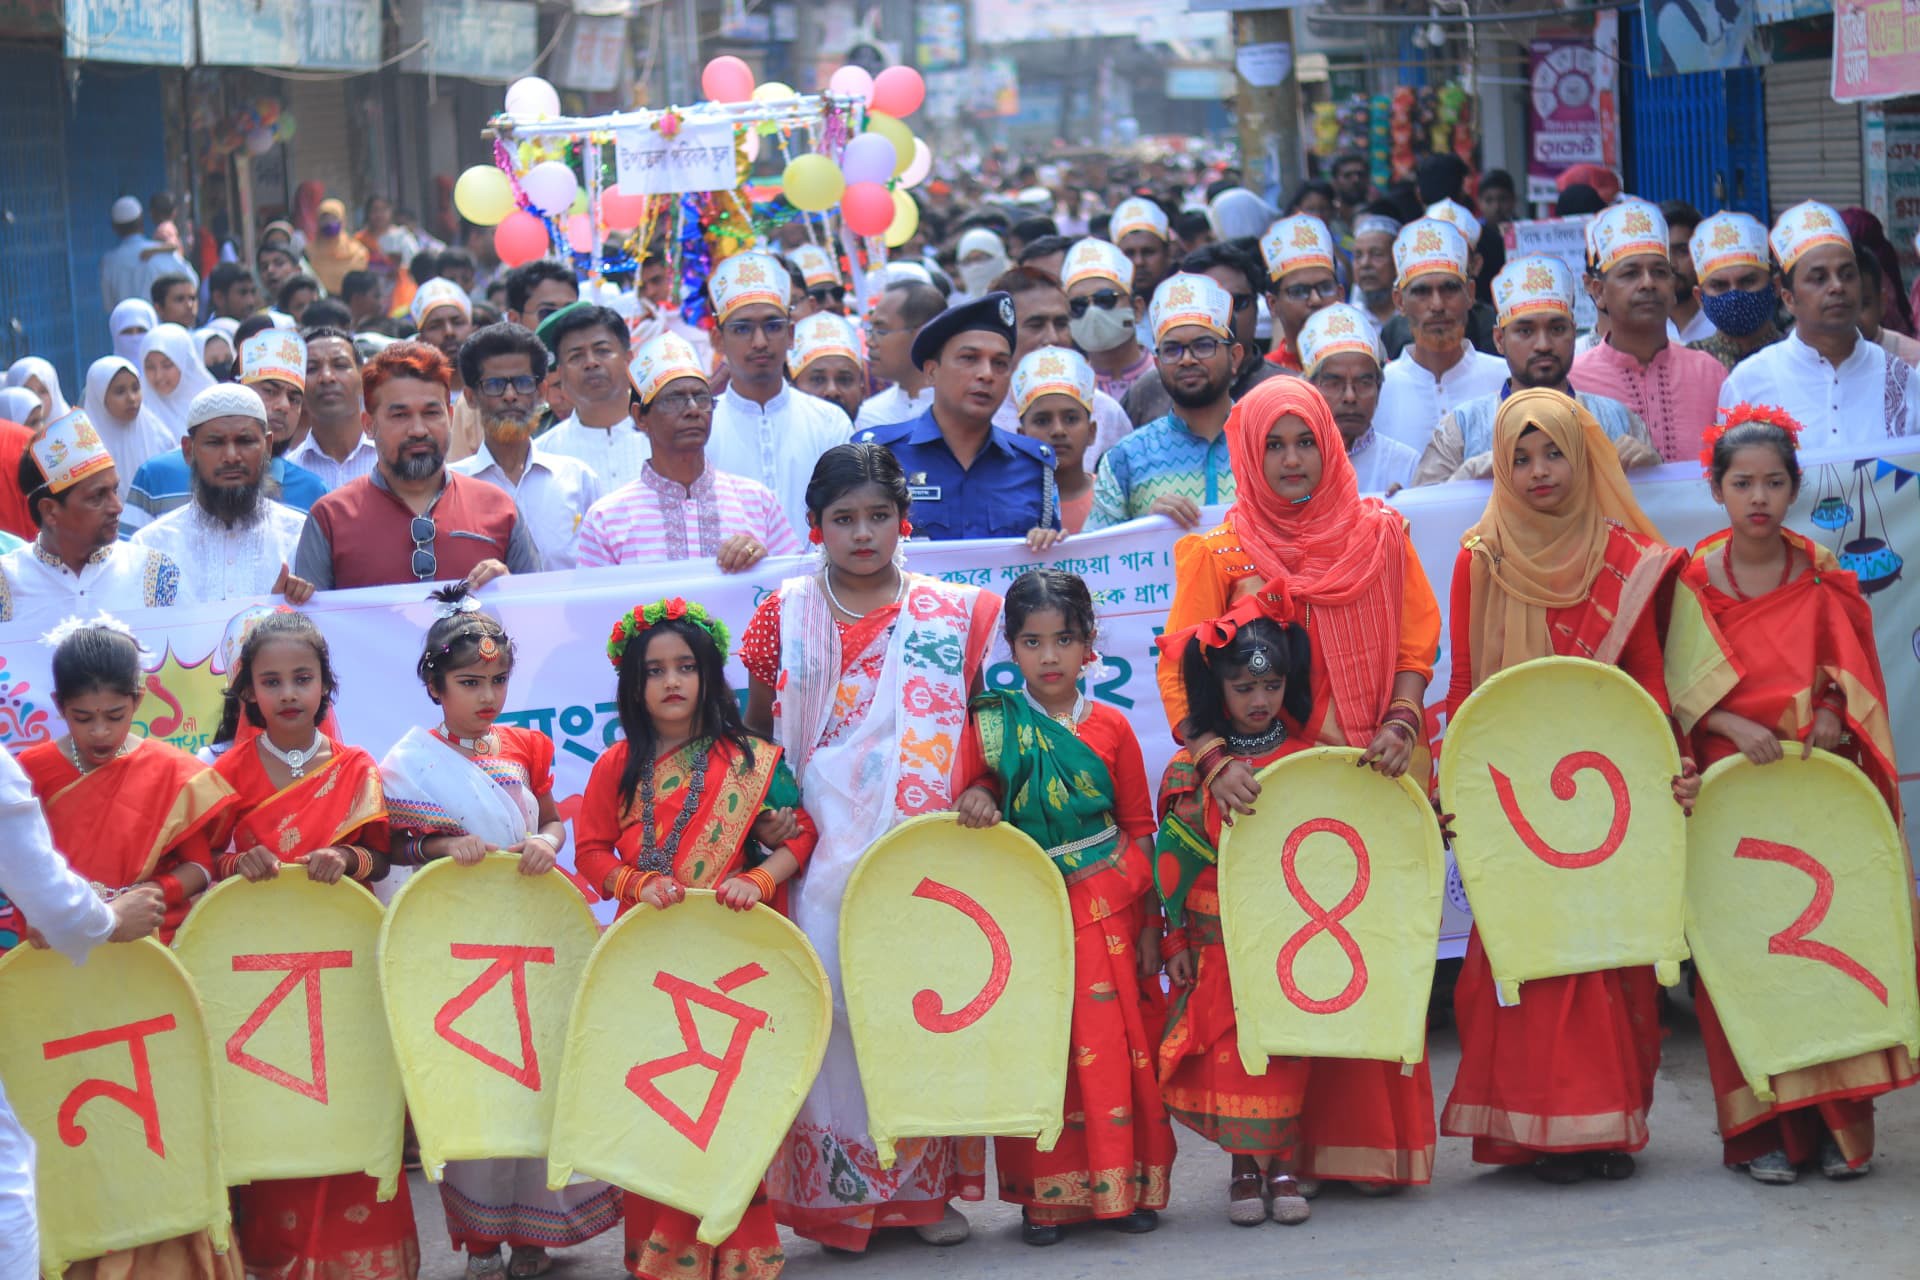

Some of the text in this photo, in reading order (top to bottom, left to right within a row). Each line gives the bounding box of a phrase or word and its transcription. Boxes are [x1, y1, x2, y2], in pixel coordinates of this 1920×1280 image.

[1120, 551, 1154, 572] গান
[1134, 583, 1169, 605] প্রাণ
[1488, 751, 1632, 870] ৩
[913, 877, 1012, 1034] ১
[1277, 818, 1371, 1015] ৪
[1735, 838, 1888, 1006] ২
[43, 1014, 177, 1159] ন
[226, 950, 353, 1104] ব
[435, 944, 555, 1092] ব
[625, 962, 769, 1153] র্ষ
